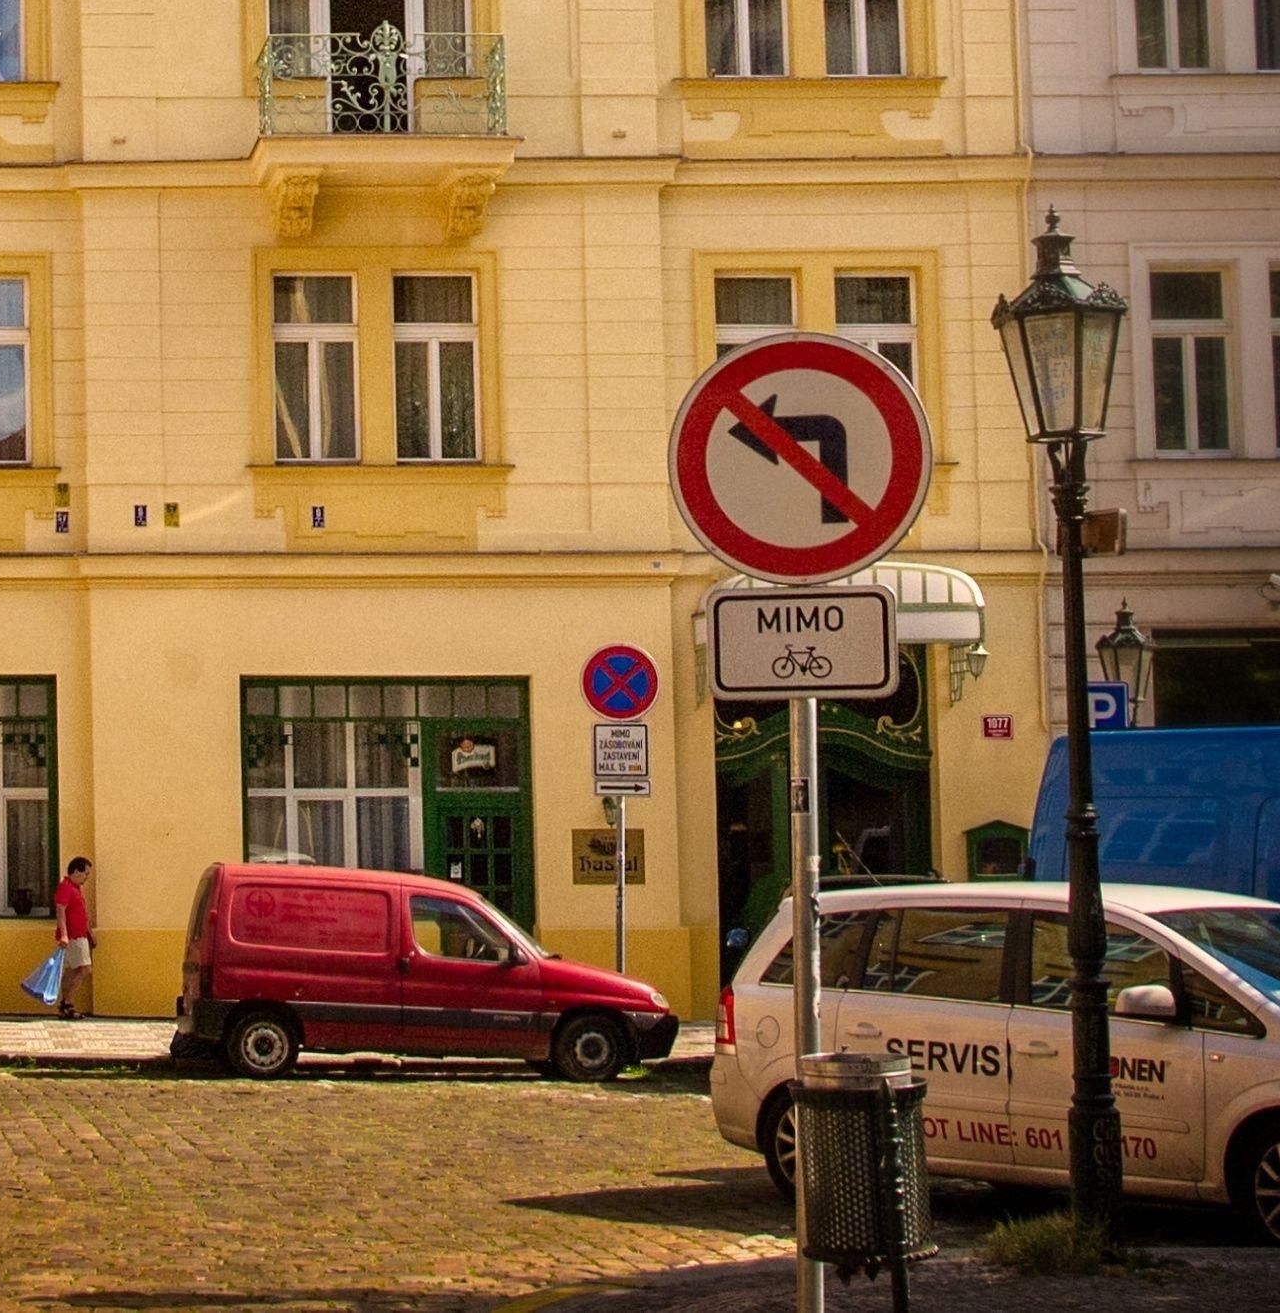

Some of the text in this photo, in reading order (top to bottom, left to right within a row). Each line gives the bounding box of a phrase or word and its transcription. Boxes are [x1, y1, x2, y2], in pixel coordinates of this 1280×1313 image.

[757, 605, 844, 633] MIMO
[1088, 692, 1117, 728] P
[986, 717, 1009, 728] 1077
[611, 729, 630, 737] MIMO
[603, 751, 640, 761] ZASTAVENÍ
[619, 763, 626, 771] 15
[886, 1038, 1000, 1077] SERVIS
[923, 1117, 948, 1138] OT
[957, 1120, 1019, 1147] LINE:
[1025, 1126, 1064, 1152] 601
